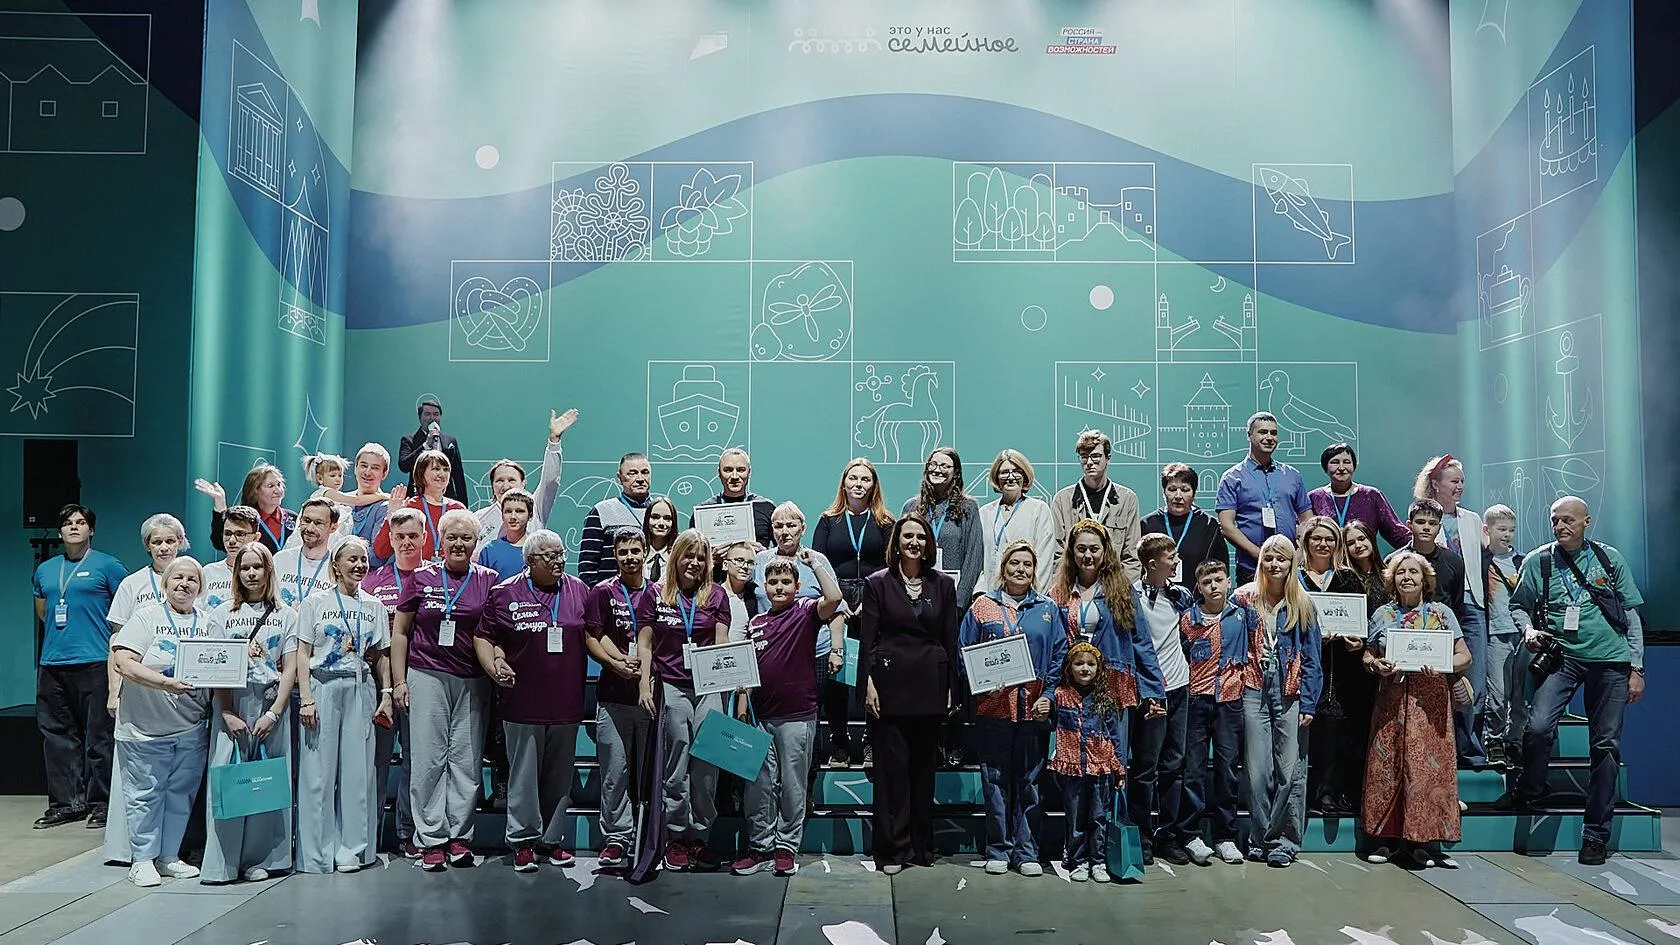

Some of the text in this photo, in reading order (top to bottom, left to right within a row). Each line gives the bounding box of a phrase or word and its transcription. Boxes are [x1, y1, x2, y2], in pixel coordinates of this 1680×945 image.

[889, 26, 951, 37] это у нас
[1062, 28, 1095, 36] РОССИЯ
[888, 32, 1019, 53] семейное
[1067, 37, 1100, 45] СТРАНА
[1047, 46, 1115, 54] ВОЗМОЖНОСТЕЙ
[512, 610, 539, 621] Семья
